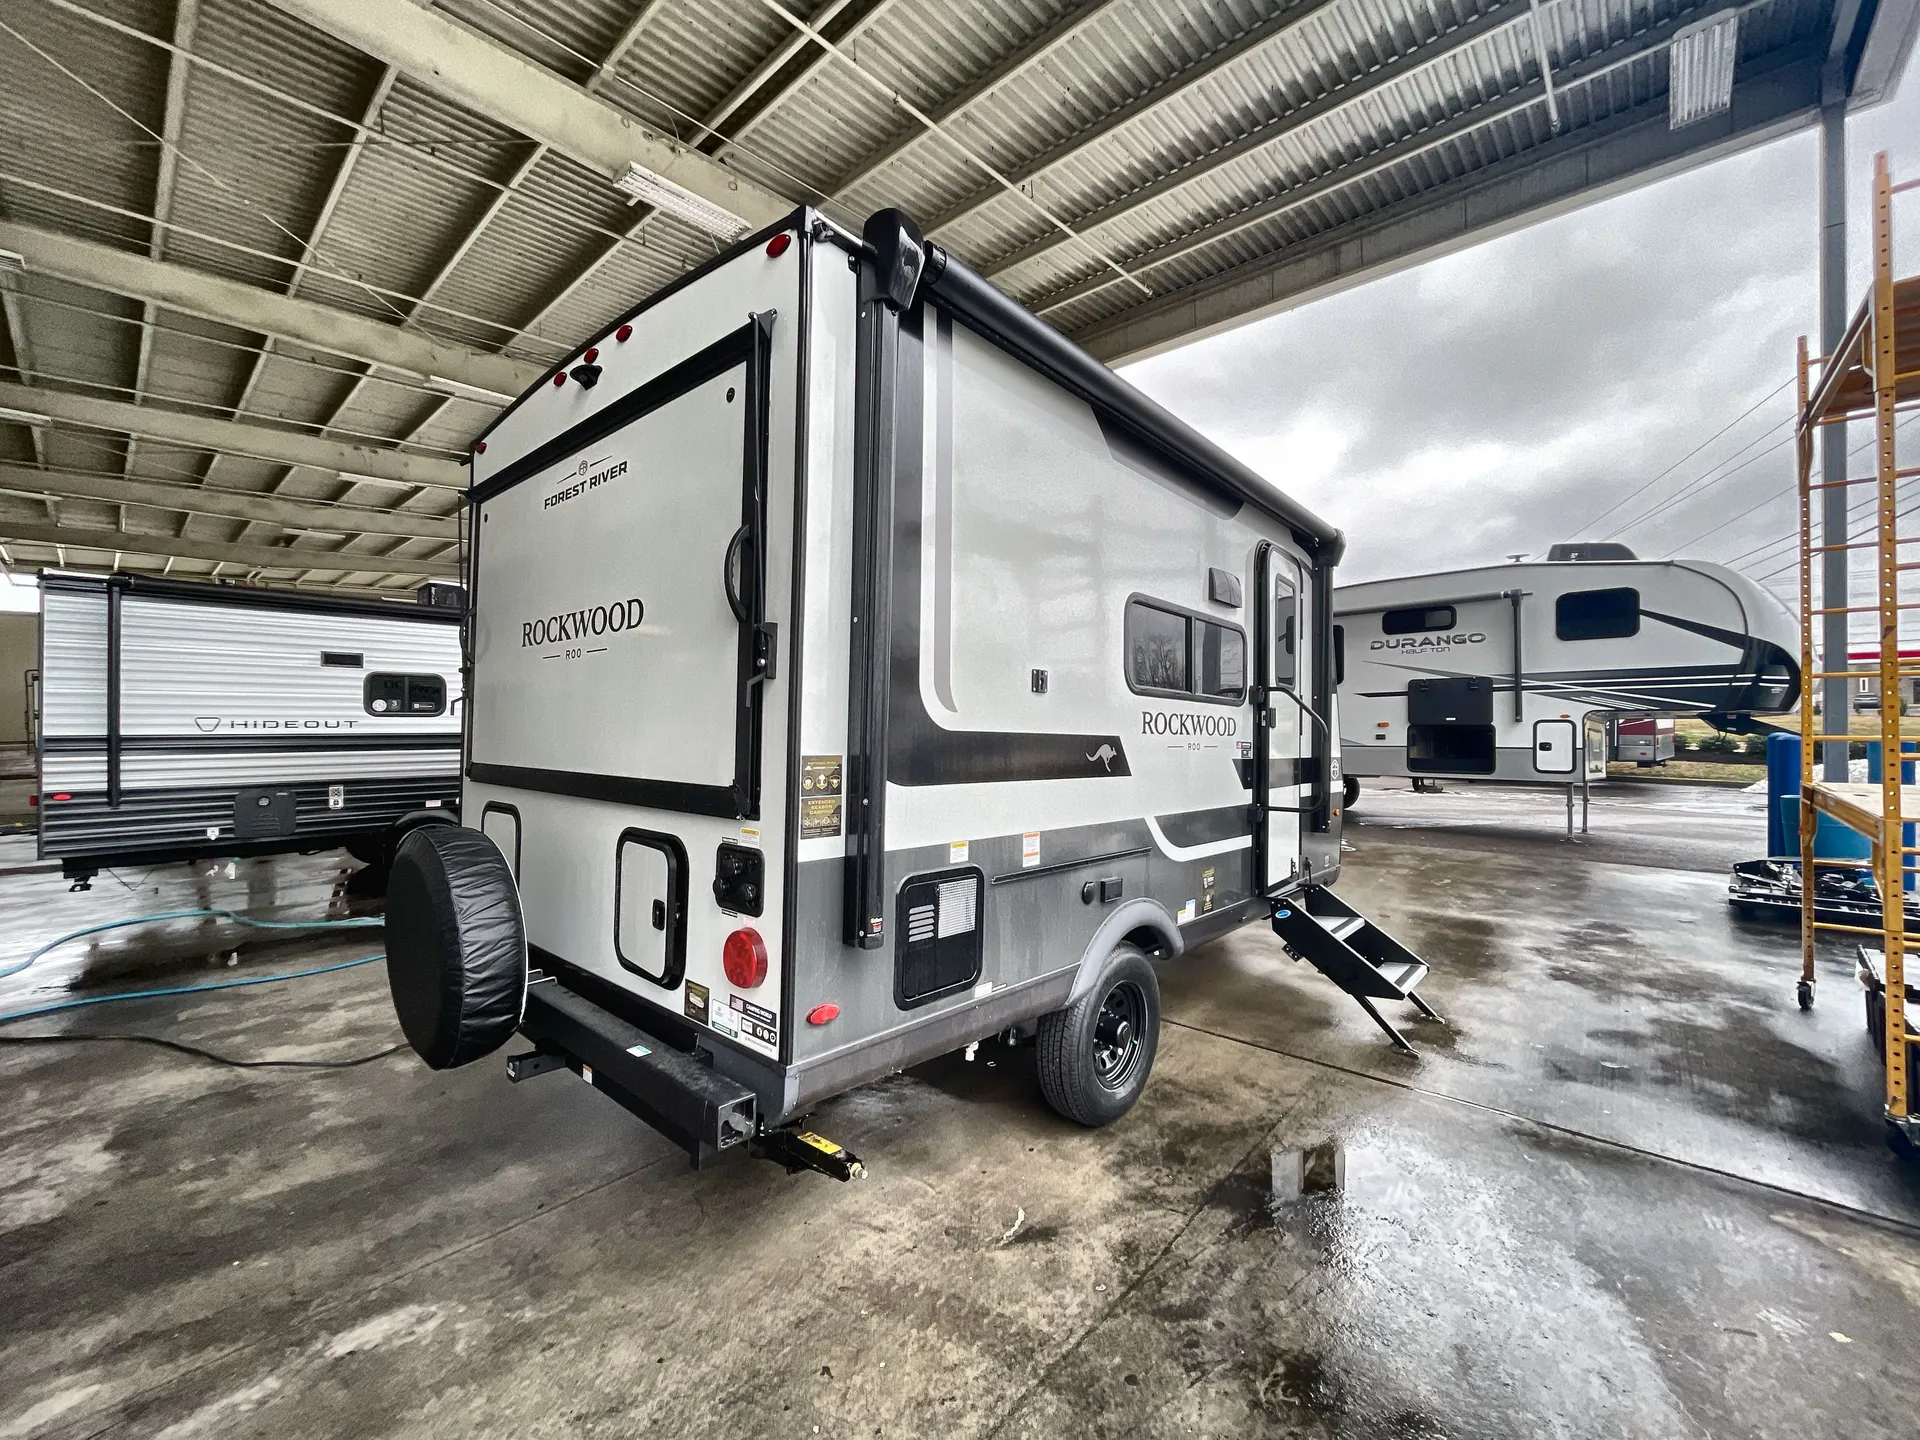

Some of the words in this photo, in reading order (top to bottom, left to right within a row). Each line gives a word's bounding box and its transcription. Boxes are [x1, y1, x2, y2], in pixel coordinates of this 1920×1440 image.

[544, 480, 587, 510] FOREST
[589, 460, 628, 489] RIVER
[522, 598, 644, 647] ROCKWOOD
[1370, 633, 1486, 650] DURANGO
[565, 648, 582, 660] ROO
[230, 720, 359, 729] HIDEOUT
[1141, 711, 1237, 736] ROCKWOOD
[1187, 743, 1201, 751] ROO
